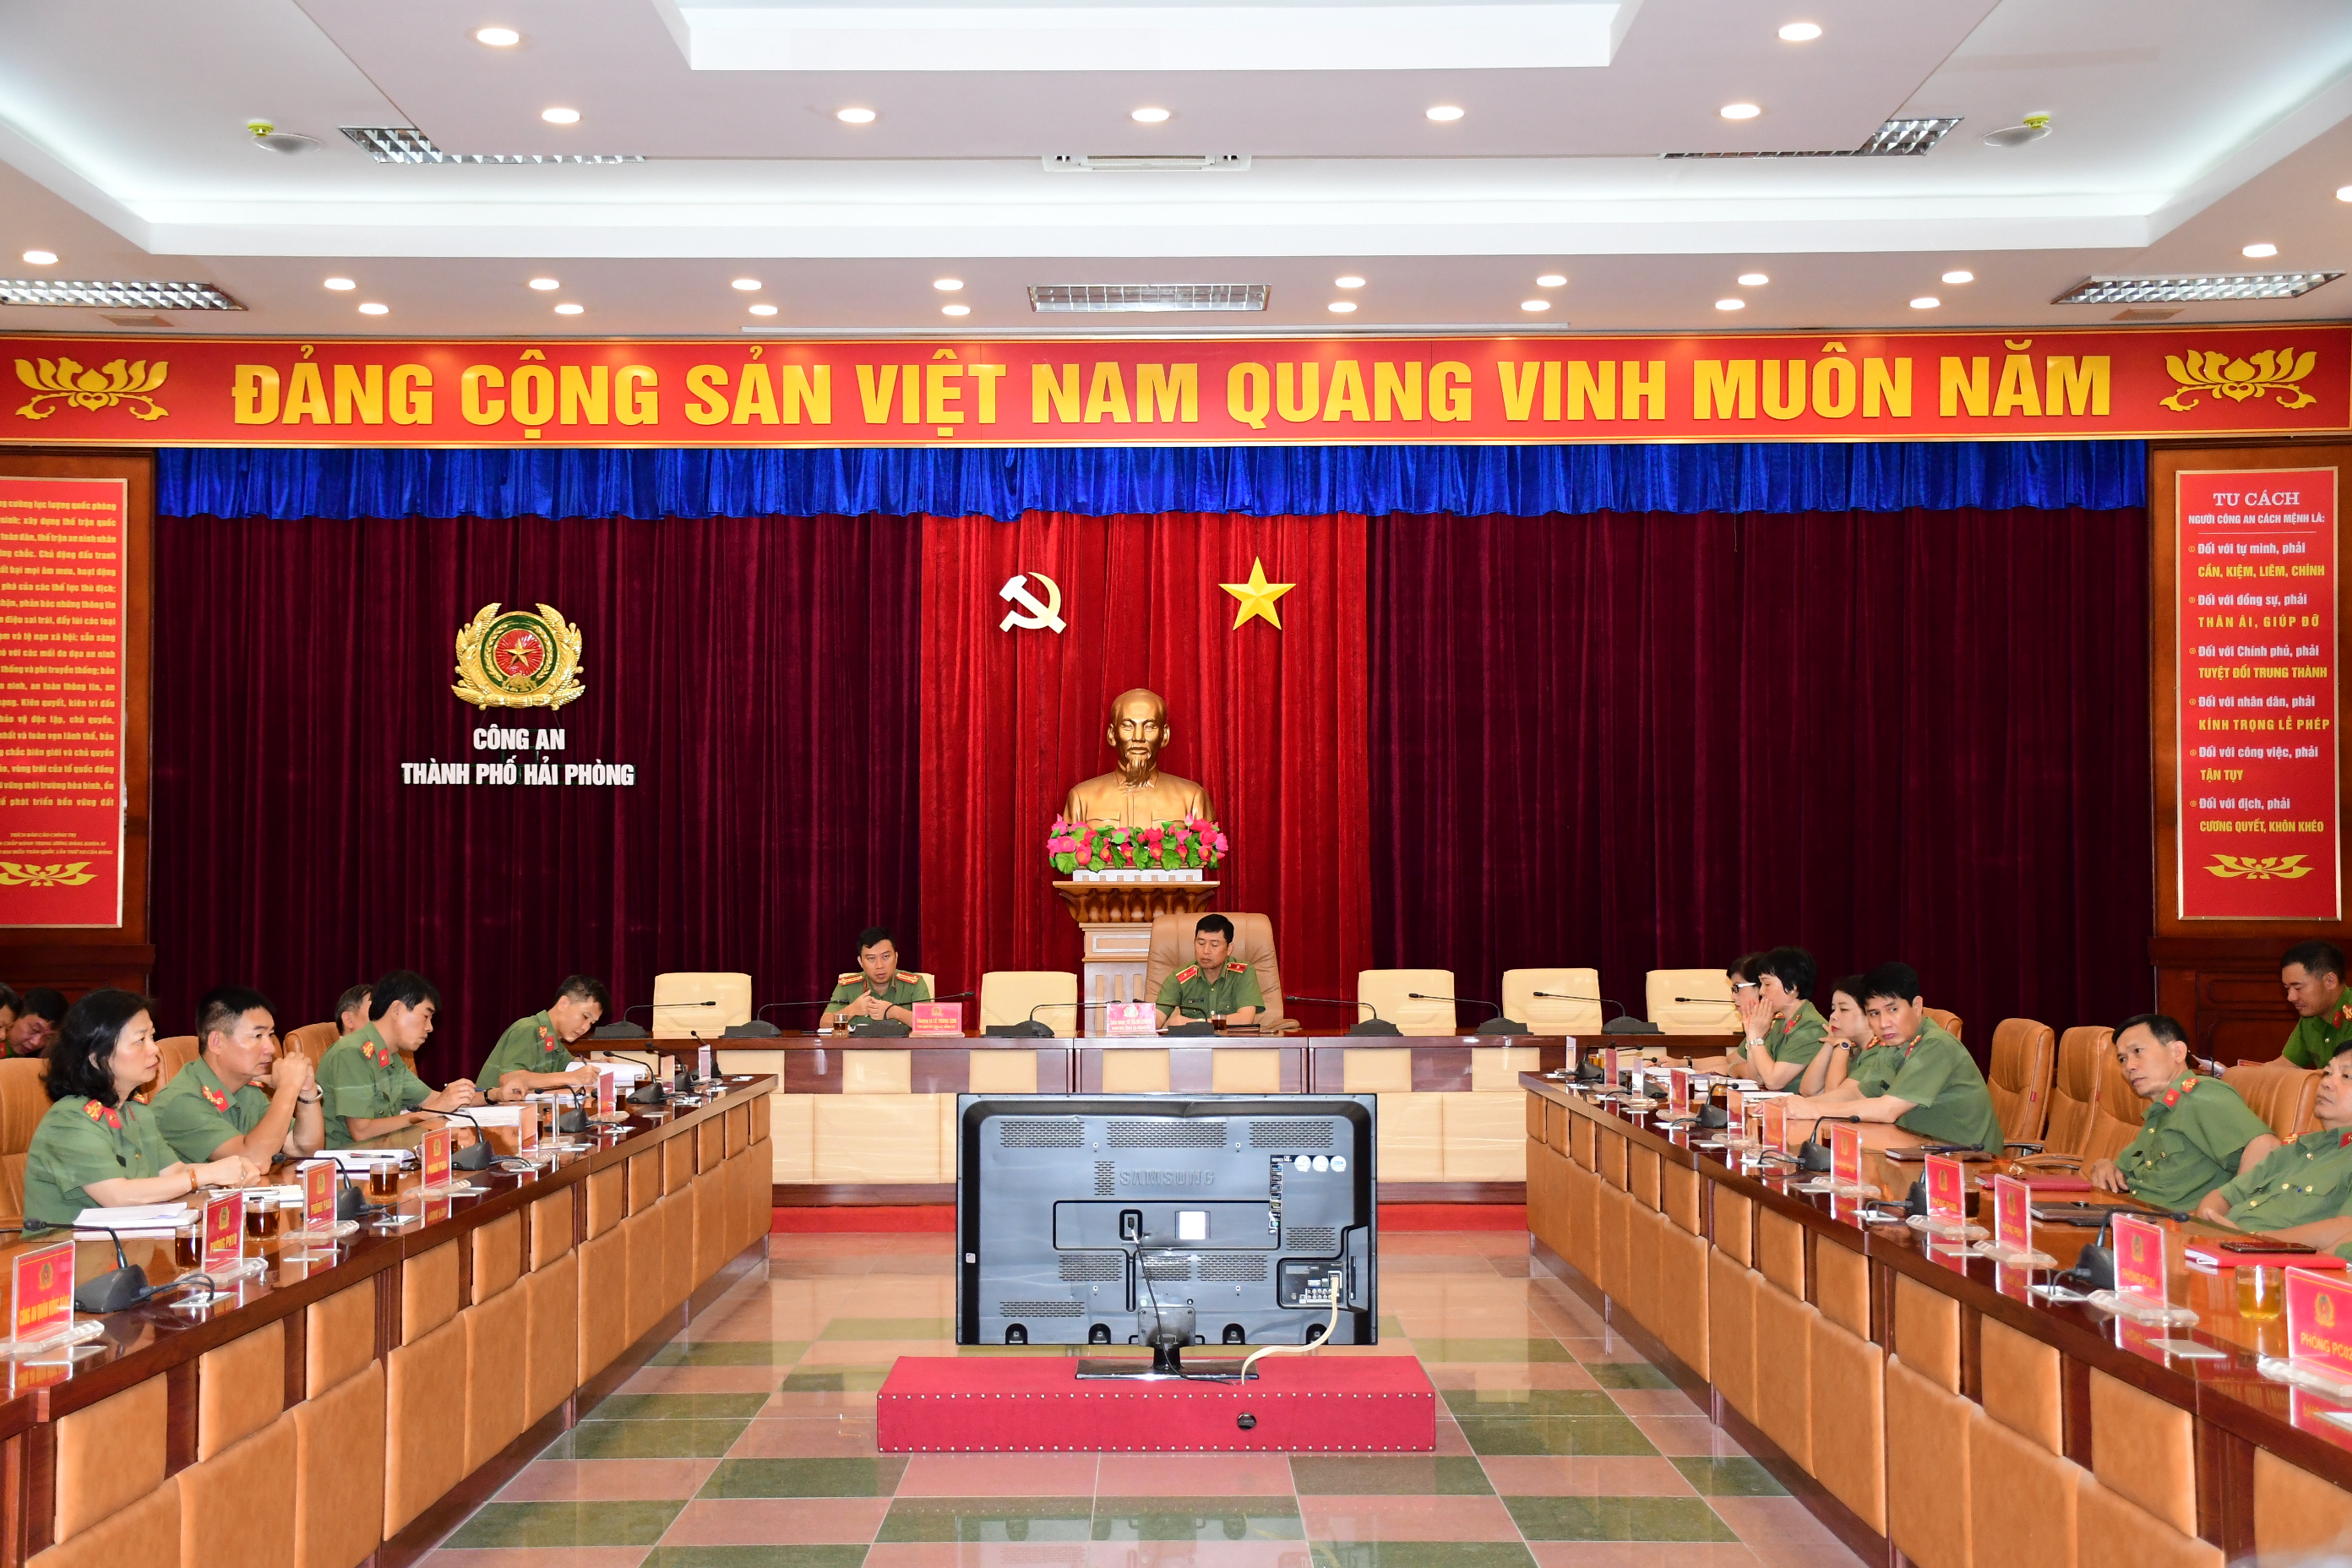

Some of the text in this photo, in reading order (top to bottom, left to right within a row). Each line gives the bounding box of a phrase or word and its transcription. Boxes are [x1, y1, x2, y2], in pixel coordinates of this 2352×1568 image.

[231, 340, 2110, 439] ĐẢNG CỘNG SẢN VIỆT NAM QUANG VINH MUÔN NĂM
[2213, 490, 2300, 506] TƯ CÁCH
[2189, 514, 2214, 524] NGƯỜI
[2218, 514, 2240, 524] CÔNG
[2258, 514, 2281, 524] CÁCH
[2284, 513, 2309, 525] MỆNH
[2311, 512, 2324, 522] LÀ:
[2198, 542, 2305, 556] Đối với tự mình, phải
[2198, 564, 2324, 579] CẦN, KIỆM, LIÊM, CHÍNH
[2198, 593, 2306, 607] Đối với đồng sự, phải
[2198, 614, 2319, 628] THÂN ÁI, GIÚP ĐỠ
[2198, 645, 2318, 657] Đối với Chính phủ, phải
[2198, 664, 2327, 680] TUYỆT ĐỐI TRUNG THÀNH
[2198, 695, 2315, 708] Đối với nhân dân, phải
[2199, 716, 2329, 732] KÍNH TRỌNG LỄ PHÉP
[473, 723, 565, 750] CÔNG AN
[2199, 745, 2318, 760] Đối với công việc, phải
[400, 754, 634, 786] THÀNH PHỐ HẢI PHÒNG
[2201, 768, 2243, 782] TẬN TỤY
[2199, 797, 2289, 811] Đối với địch, phải
[2200, 818, 2323, 833] CƯƠNG QUYẾT, KHÔN KHÉO
[1120, 1171, 1214, 1185] SAMSUNG
